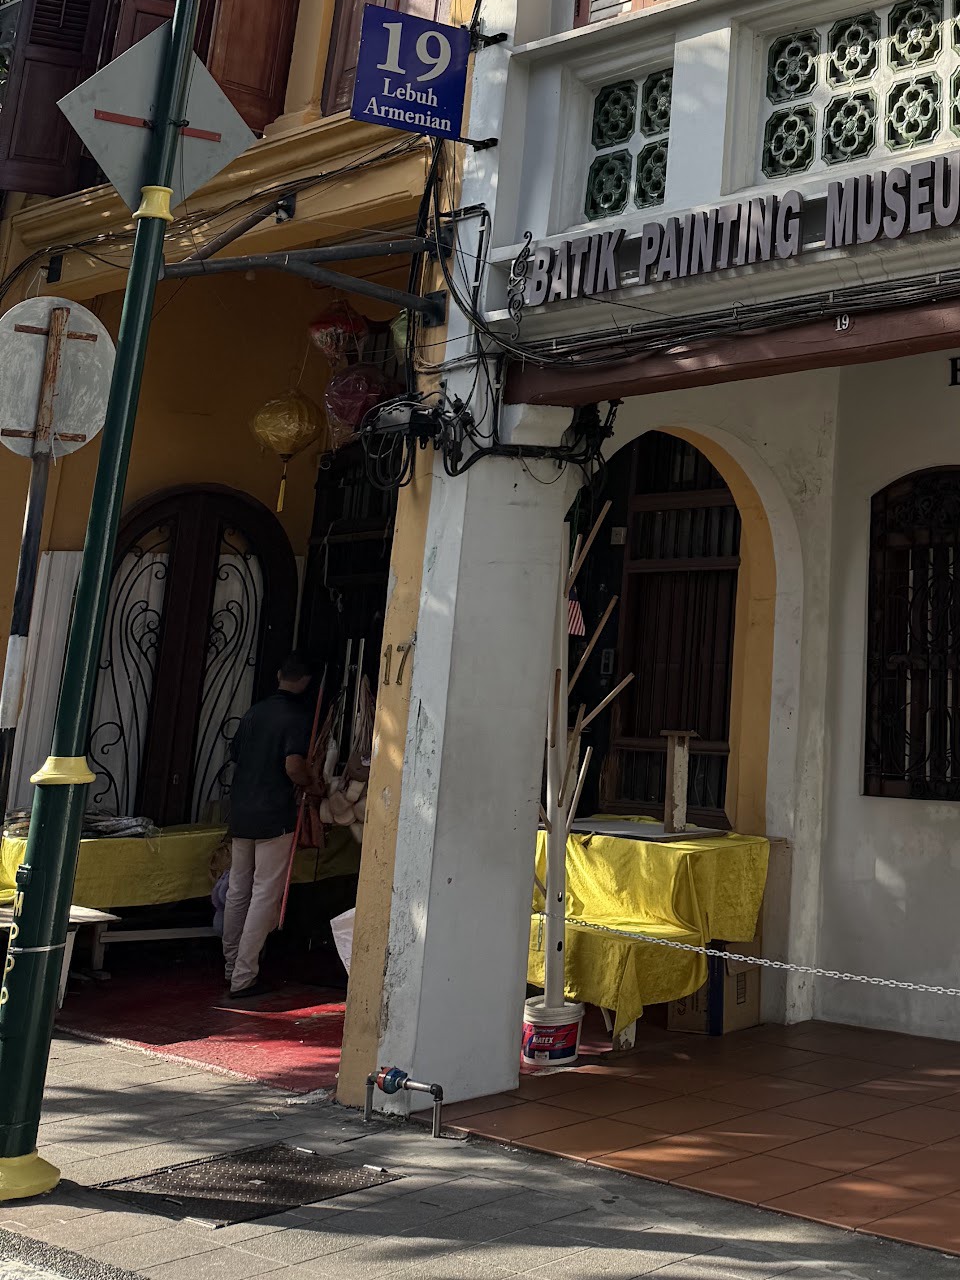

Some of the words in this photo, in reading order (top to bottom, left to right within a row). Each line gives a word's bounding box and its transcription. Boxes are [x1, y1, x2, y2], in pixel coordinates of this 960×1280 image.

[376, 22, 452, 82] 19
[381, 77, 438, 107] Lebuh
[363, 96, 452, 132] Armenian
[529, 228, 626, 308] BATIK
[638, 190, 803, 286] PAINTING
[835, 314, 850, 331] 19
[383, 643, 412, 686] 17
